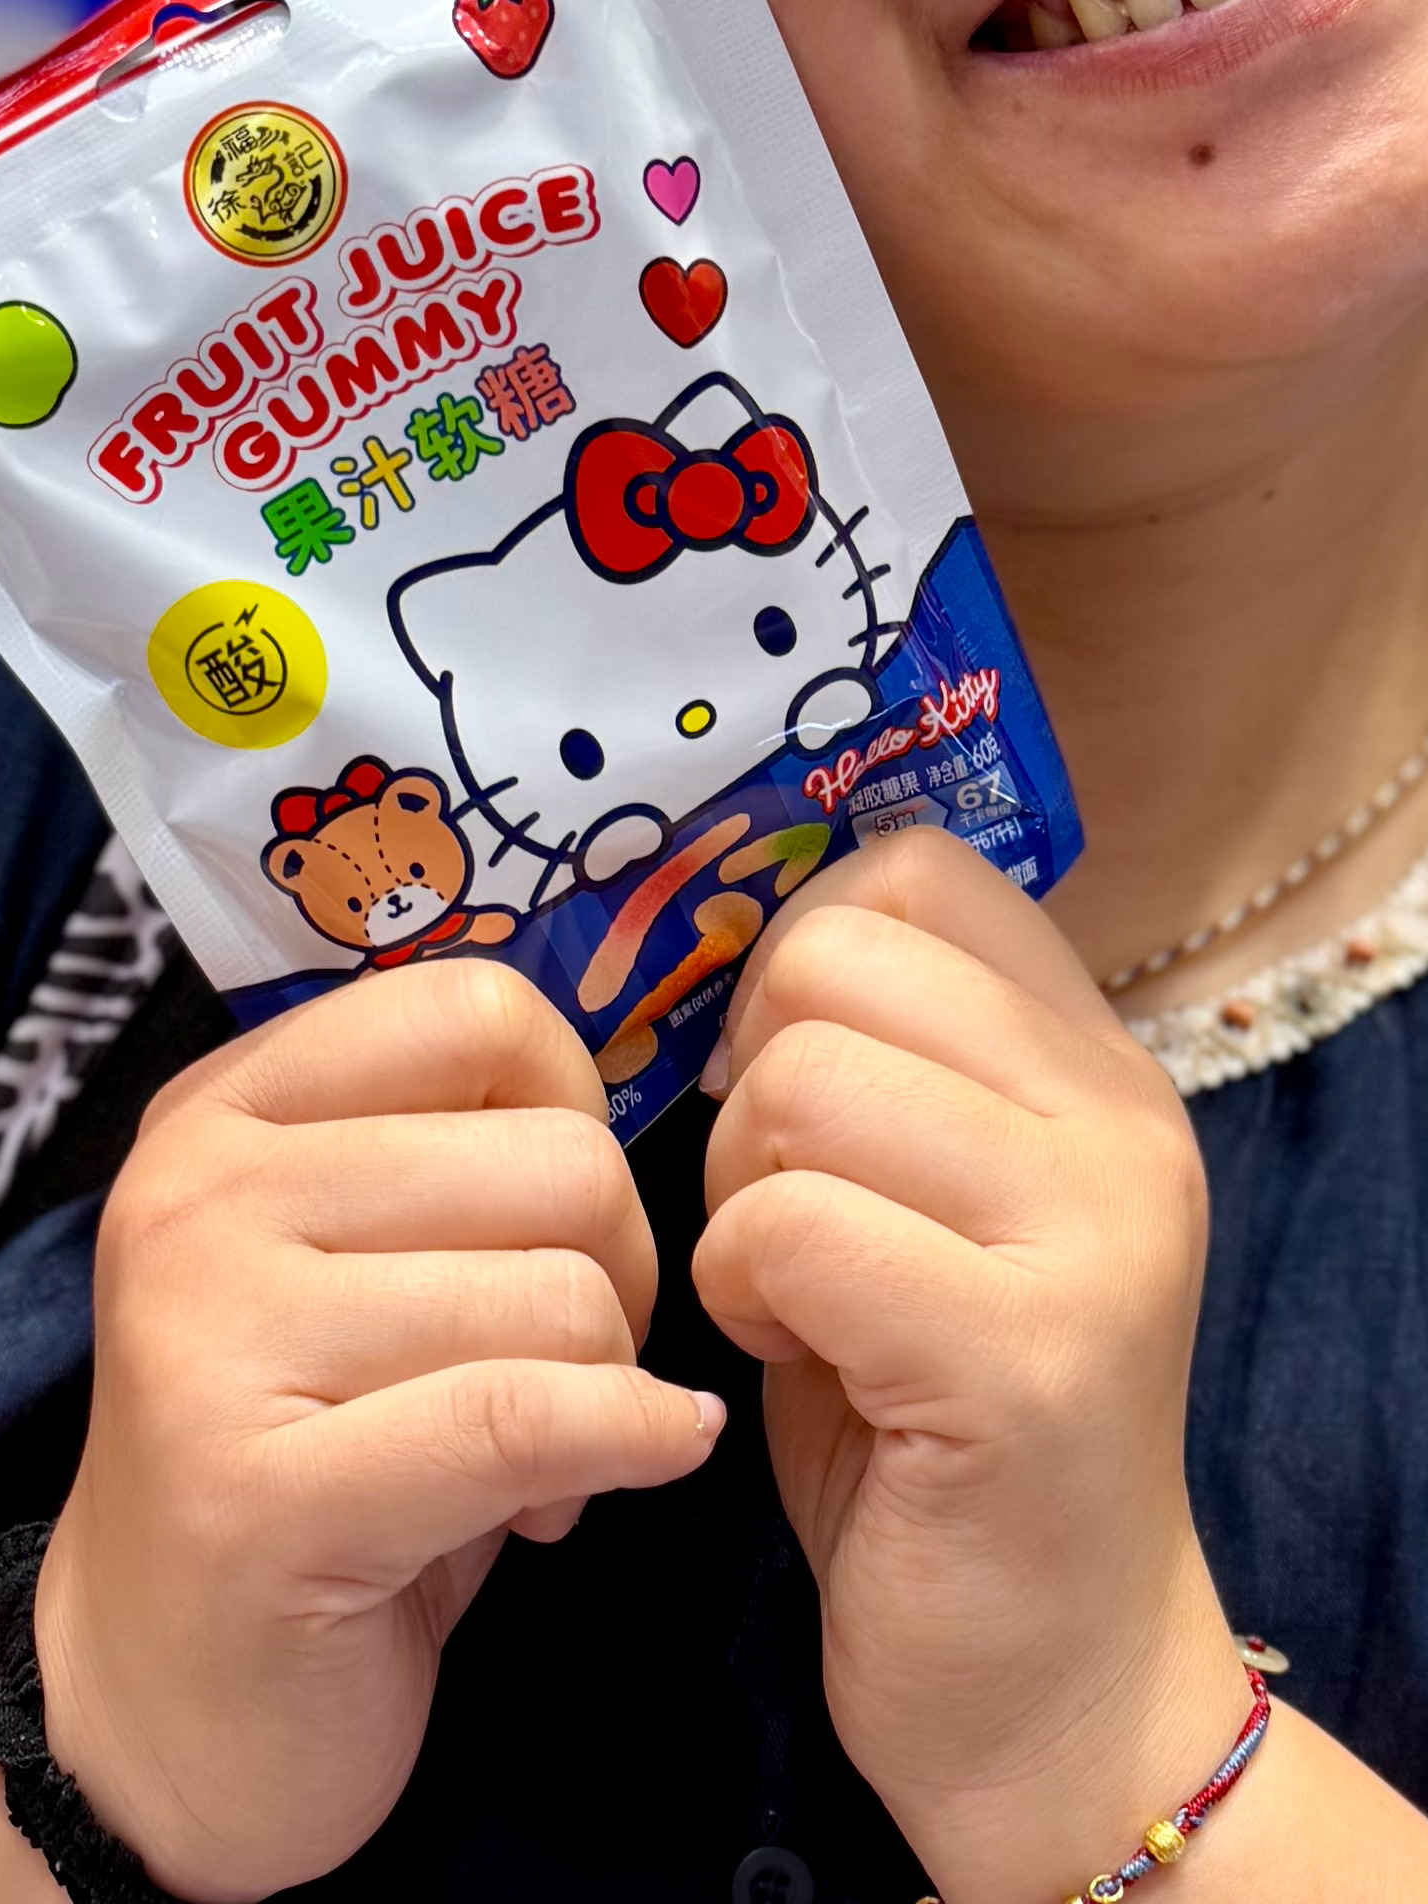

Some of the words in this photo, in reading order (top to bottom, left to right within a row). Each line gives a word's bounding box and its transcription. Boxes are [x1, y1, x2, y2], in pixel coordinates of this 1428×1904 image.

[90, 279, 320, 501] FRUIT
[341, 166, 598, 316] JUICE
[217, 271, 519, 491] GUMMY
[261, 343, 577, 575] 果汁软糖
[196, 634, 281, 709] 酸
[803, 726, 918, 815] Hello
[917, 669, 1000, 750] Kitty
[848, 770, 921, 817] 凝胶糖果
[957, 769, 1000, 810] 67
